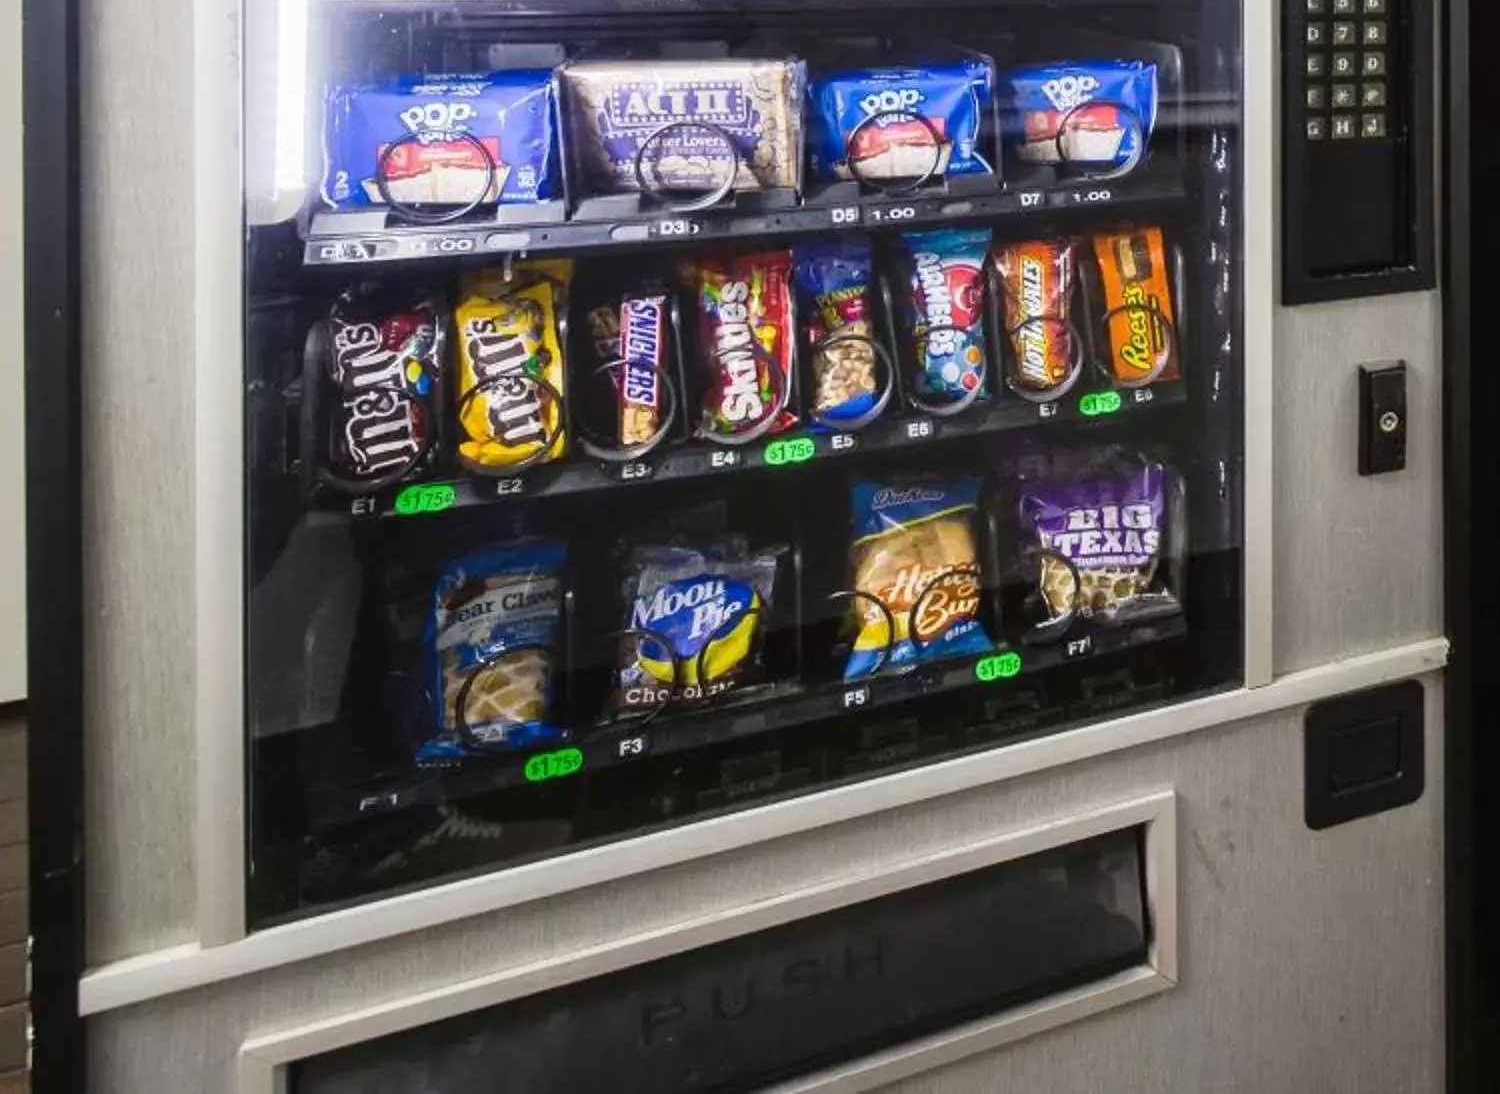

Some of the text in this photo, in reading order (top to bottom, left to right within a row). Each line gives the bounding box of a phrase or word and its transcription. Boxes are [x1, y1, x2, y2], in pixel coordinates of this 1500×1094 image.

[1307, 26, 1320, 41] D
[1338, 26, 1349, 41] 7
[1338, 57, 1349, 72] 9
[624, 89, 732, 115] ACT II
[1335, 120, 1349, 135] H
[1367, 118, 1378, 133] J
[1020, 190, 1112, 207] D7 1.00
[831, 207, 916, 223] D5 1.00
[660, 220, 685, 235] D3
[1120, 282, 1153, 372] Reese's
[711, 451, 736, 467] E4
[621, 464, 646, 479] E3
[497, 478, 524, 495] E2
[351, 497, 376, 515] E1
[1067, 502, 1152, 531] BIG
[1053, 529, 1161, 557] TEXAS
[631, 580, 726, 630] Moon
[687, 598, 744, 641] Pie
[1067, 638, 1089, 656] F7
[843, 689, 867, 708] F5
[618, 737, 644, 757] F3
[638, 937, 884, 1050] PUSH
